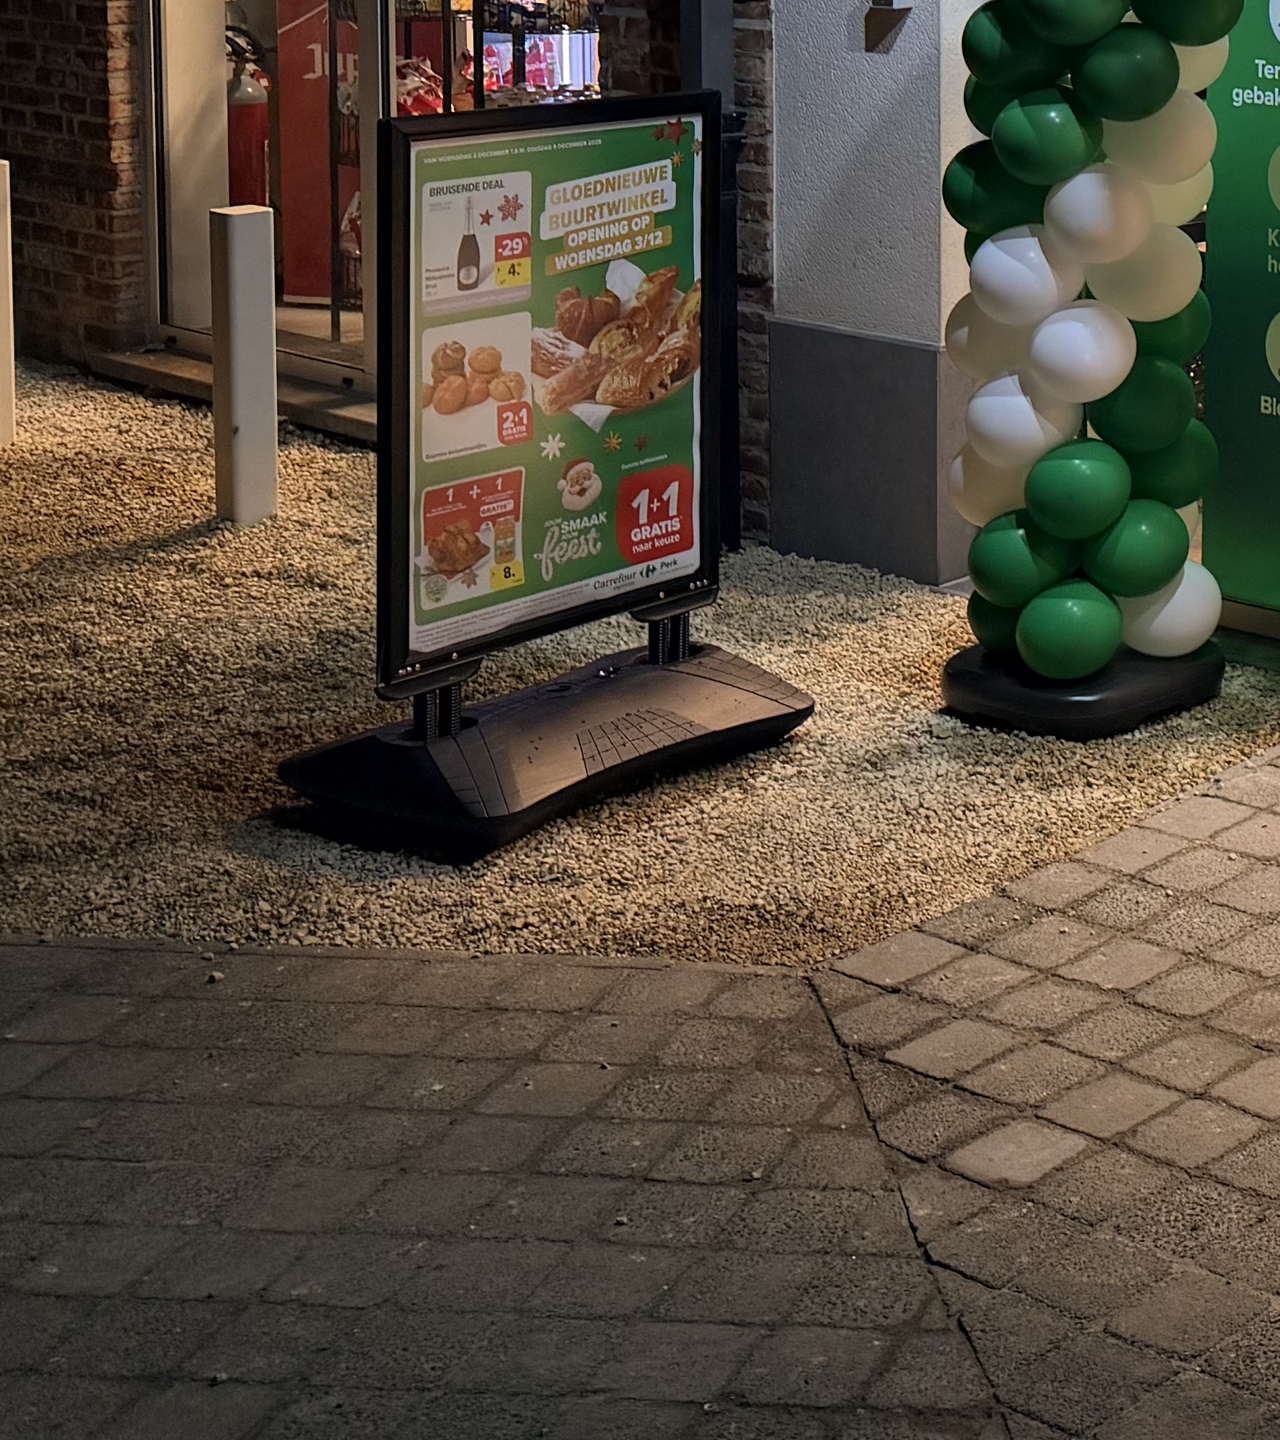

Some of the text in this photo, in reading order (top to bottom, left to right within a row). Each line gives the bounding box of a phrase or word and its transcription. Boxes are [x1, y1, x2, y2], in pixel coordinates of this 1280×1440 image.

[428, 179, 505, 198] BRUISENDE DEAL
[550, 164, 668, 206] GLOEDNIEUWE
[549, 188, 668, 231] BUURTWINKEL
[567, 215, 651, 248] OPENING OP
[555, 231, 663, 270] WOENSDAG 3/12
[631, 479, 680, 525] 1+1
[561, 511, 608, 534] SMAAK
[632, 534, 681, 555] naar keuze
[593, 571, 637, 590] Carrefour
